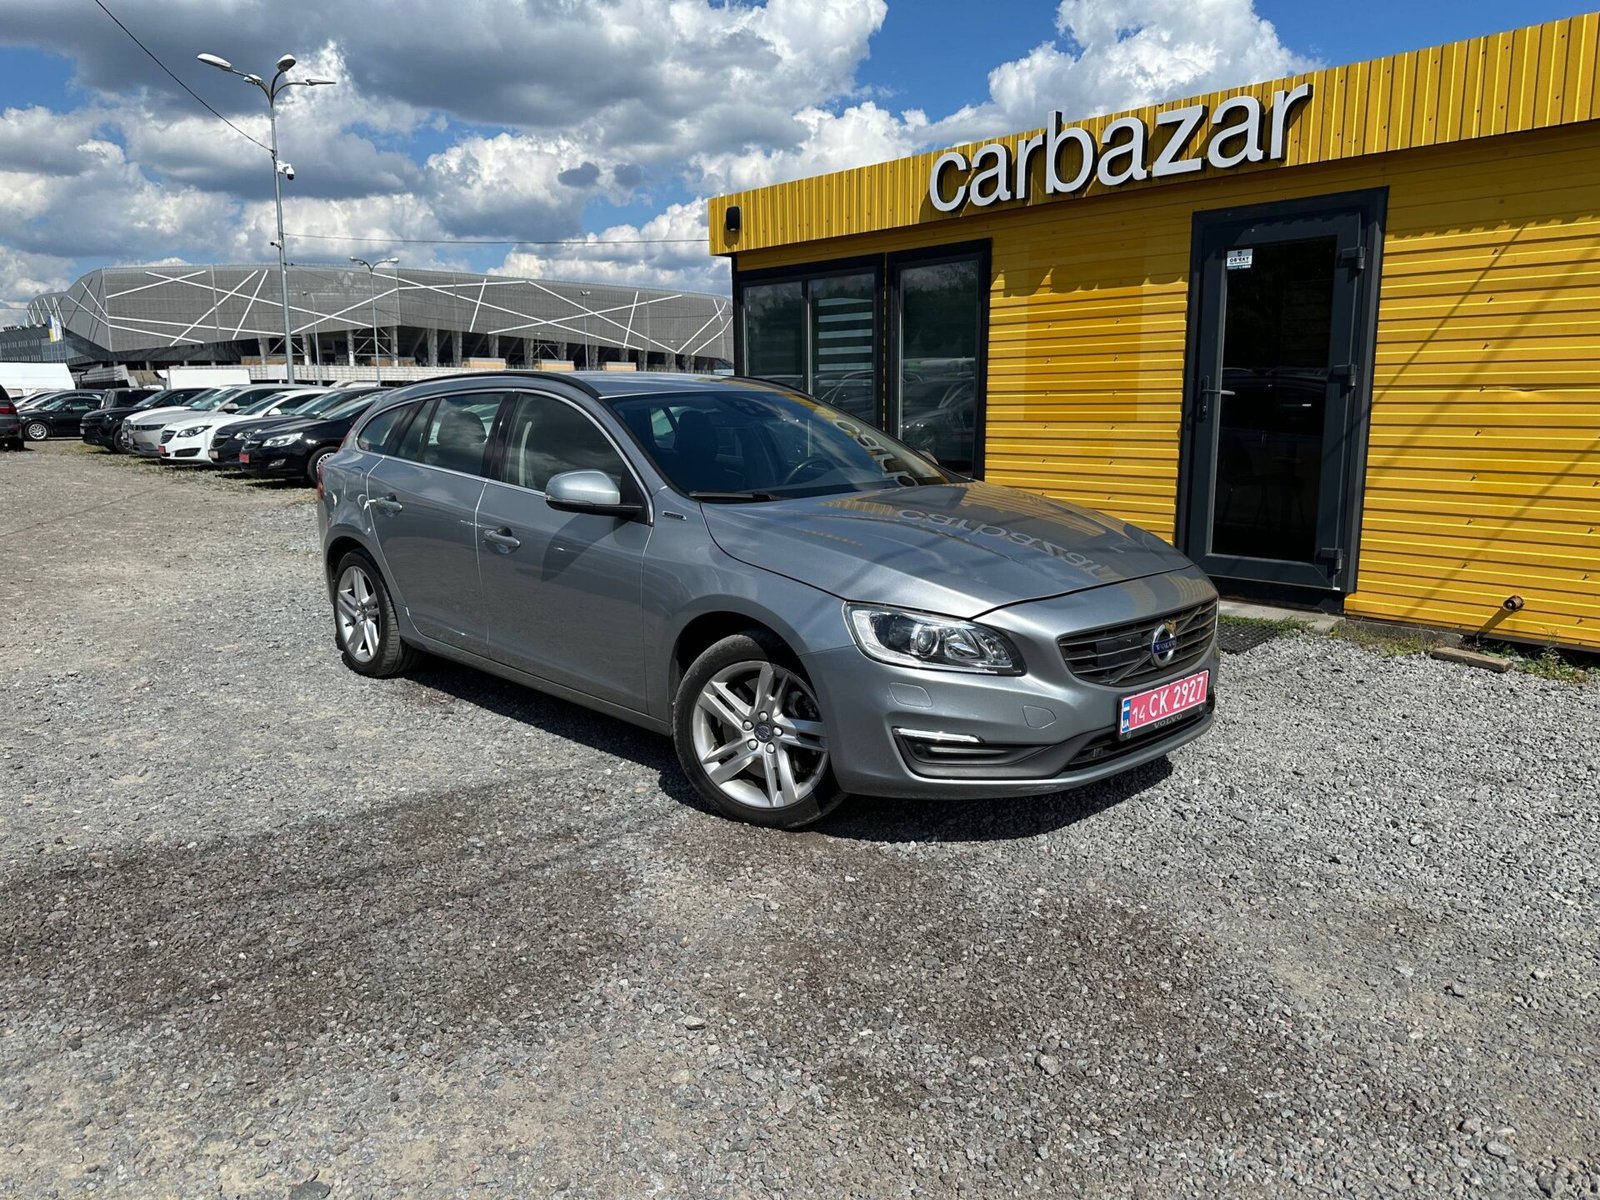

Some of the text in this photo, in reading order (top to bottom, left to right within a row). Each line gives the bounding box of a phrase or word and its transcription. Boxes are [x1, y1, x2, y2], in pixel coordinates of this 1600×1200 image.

[929, 83, 1311, 212] carbazar
[1155, 641, 1176, 651] VOLVO
[1132, 677, 1204, 724] 14 CK 2927
[1153, 714, 1183, 728] VOLVO
